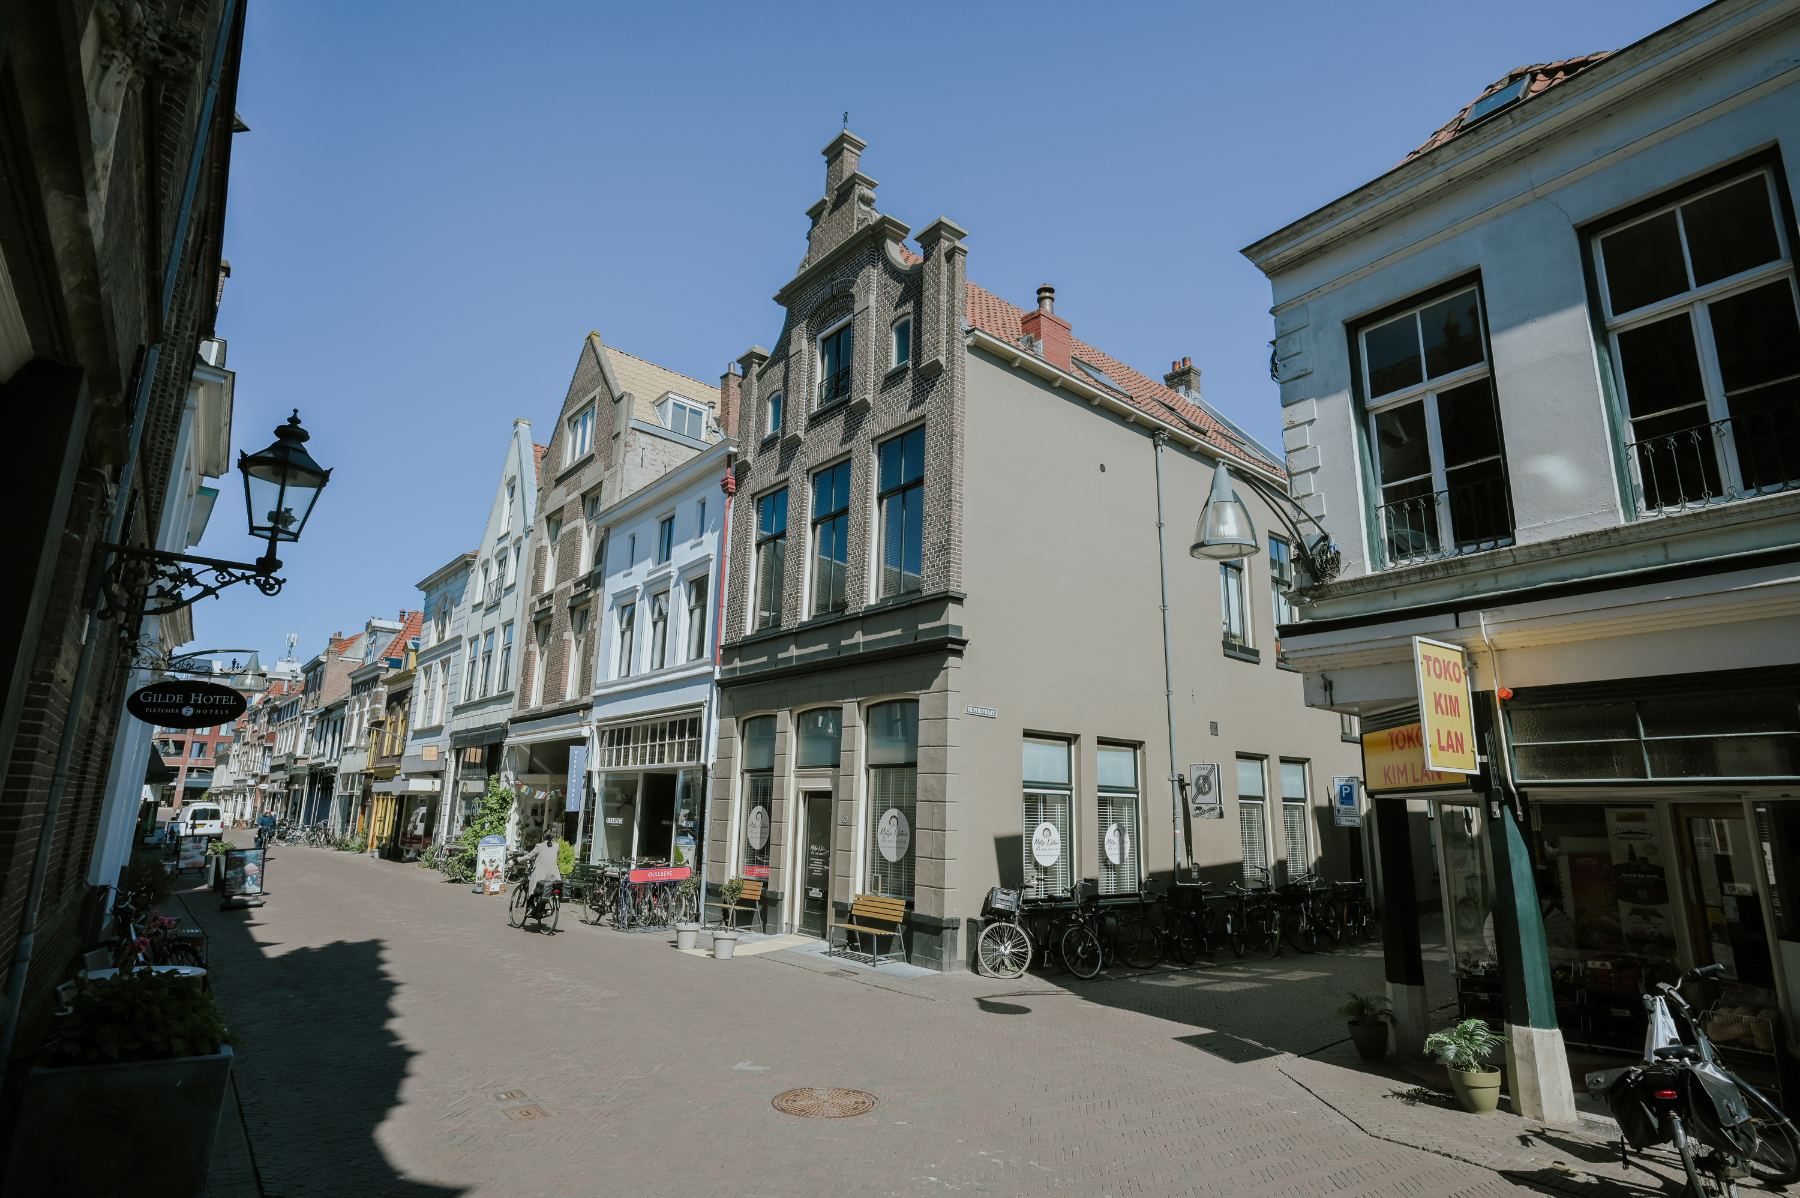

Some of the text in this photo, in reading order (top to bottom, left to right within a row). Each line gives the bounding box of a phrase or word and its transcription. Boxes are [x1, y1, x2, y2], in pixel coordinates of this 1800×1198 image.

[1423, 654, 1462, 683] TOKO
[140, 691, 236, 704] GILDE HOTEL
[1433, 691, 1460, 718] KIM
[1436, 728, 1464, 754] LAN
[1383, 762, 1408, 785] KIM
[1342, 785, 1351, 798] P
